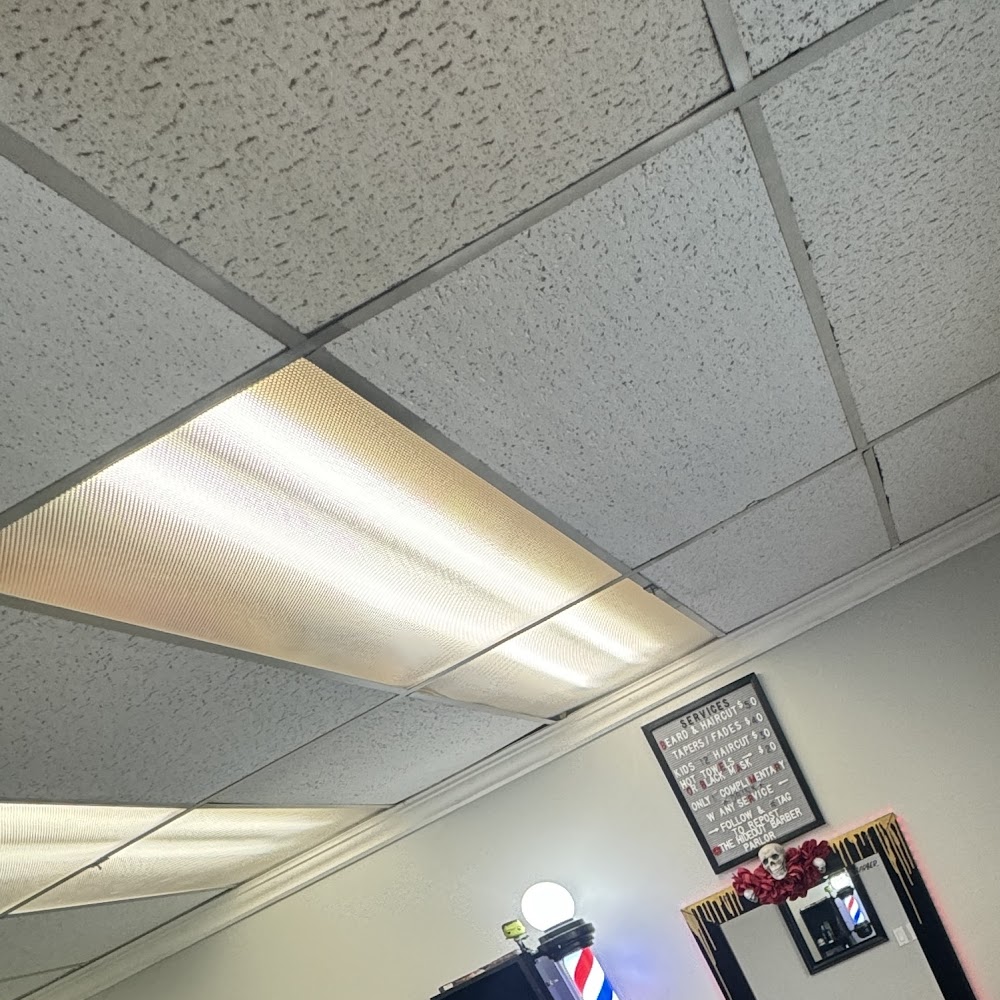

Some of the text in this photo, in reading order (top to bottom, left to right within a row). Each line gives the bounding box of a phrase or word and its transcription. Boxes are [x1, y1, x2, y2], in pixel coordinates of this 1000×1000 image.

[659, 729, 689, 751] BEARD
[690, 724, 699, 735] &
[700, 705, 738, 730] HAIRCUT
[680, 698, 729, 728] SERVICES
[711, 720, 741, 741] FADES
[673, 762, 695, 778] KIDS
[713, 735, 750, 760] HAIRCUT
[680, 775, 697, 789] HOT
[700, 757, 734, 780] TOWELS
[686, 758, 751, 796] OR BLACK MASK
[691, 796, 711, 811] ONLY
[719, 760, 785, 798] COMPLIMENTARY
[718, 803, 736, 817] ANY
[737, 785, 773, 808] SERVICE
[720, 810, 753, 832] FOLLOW
[756, 804, 765, 815] &
[732, 809, 780, 837] TO REPOST
[736, 824, 767, 845] HIDEOUT
[769, 807, 801, 828] BARBER
[743, 831, 776, 852] PARLOR
